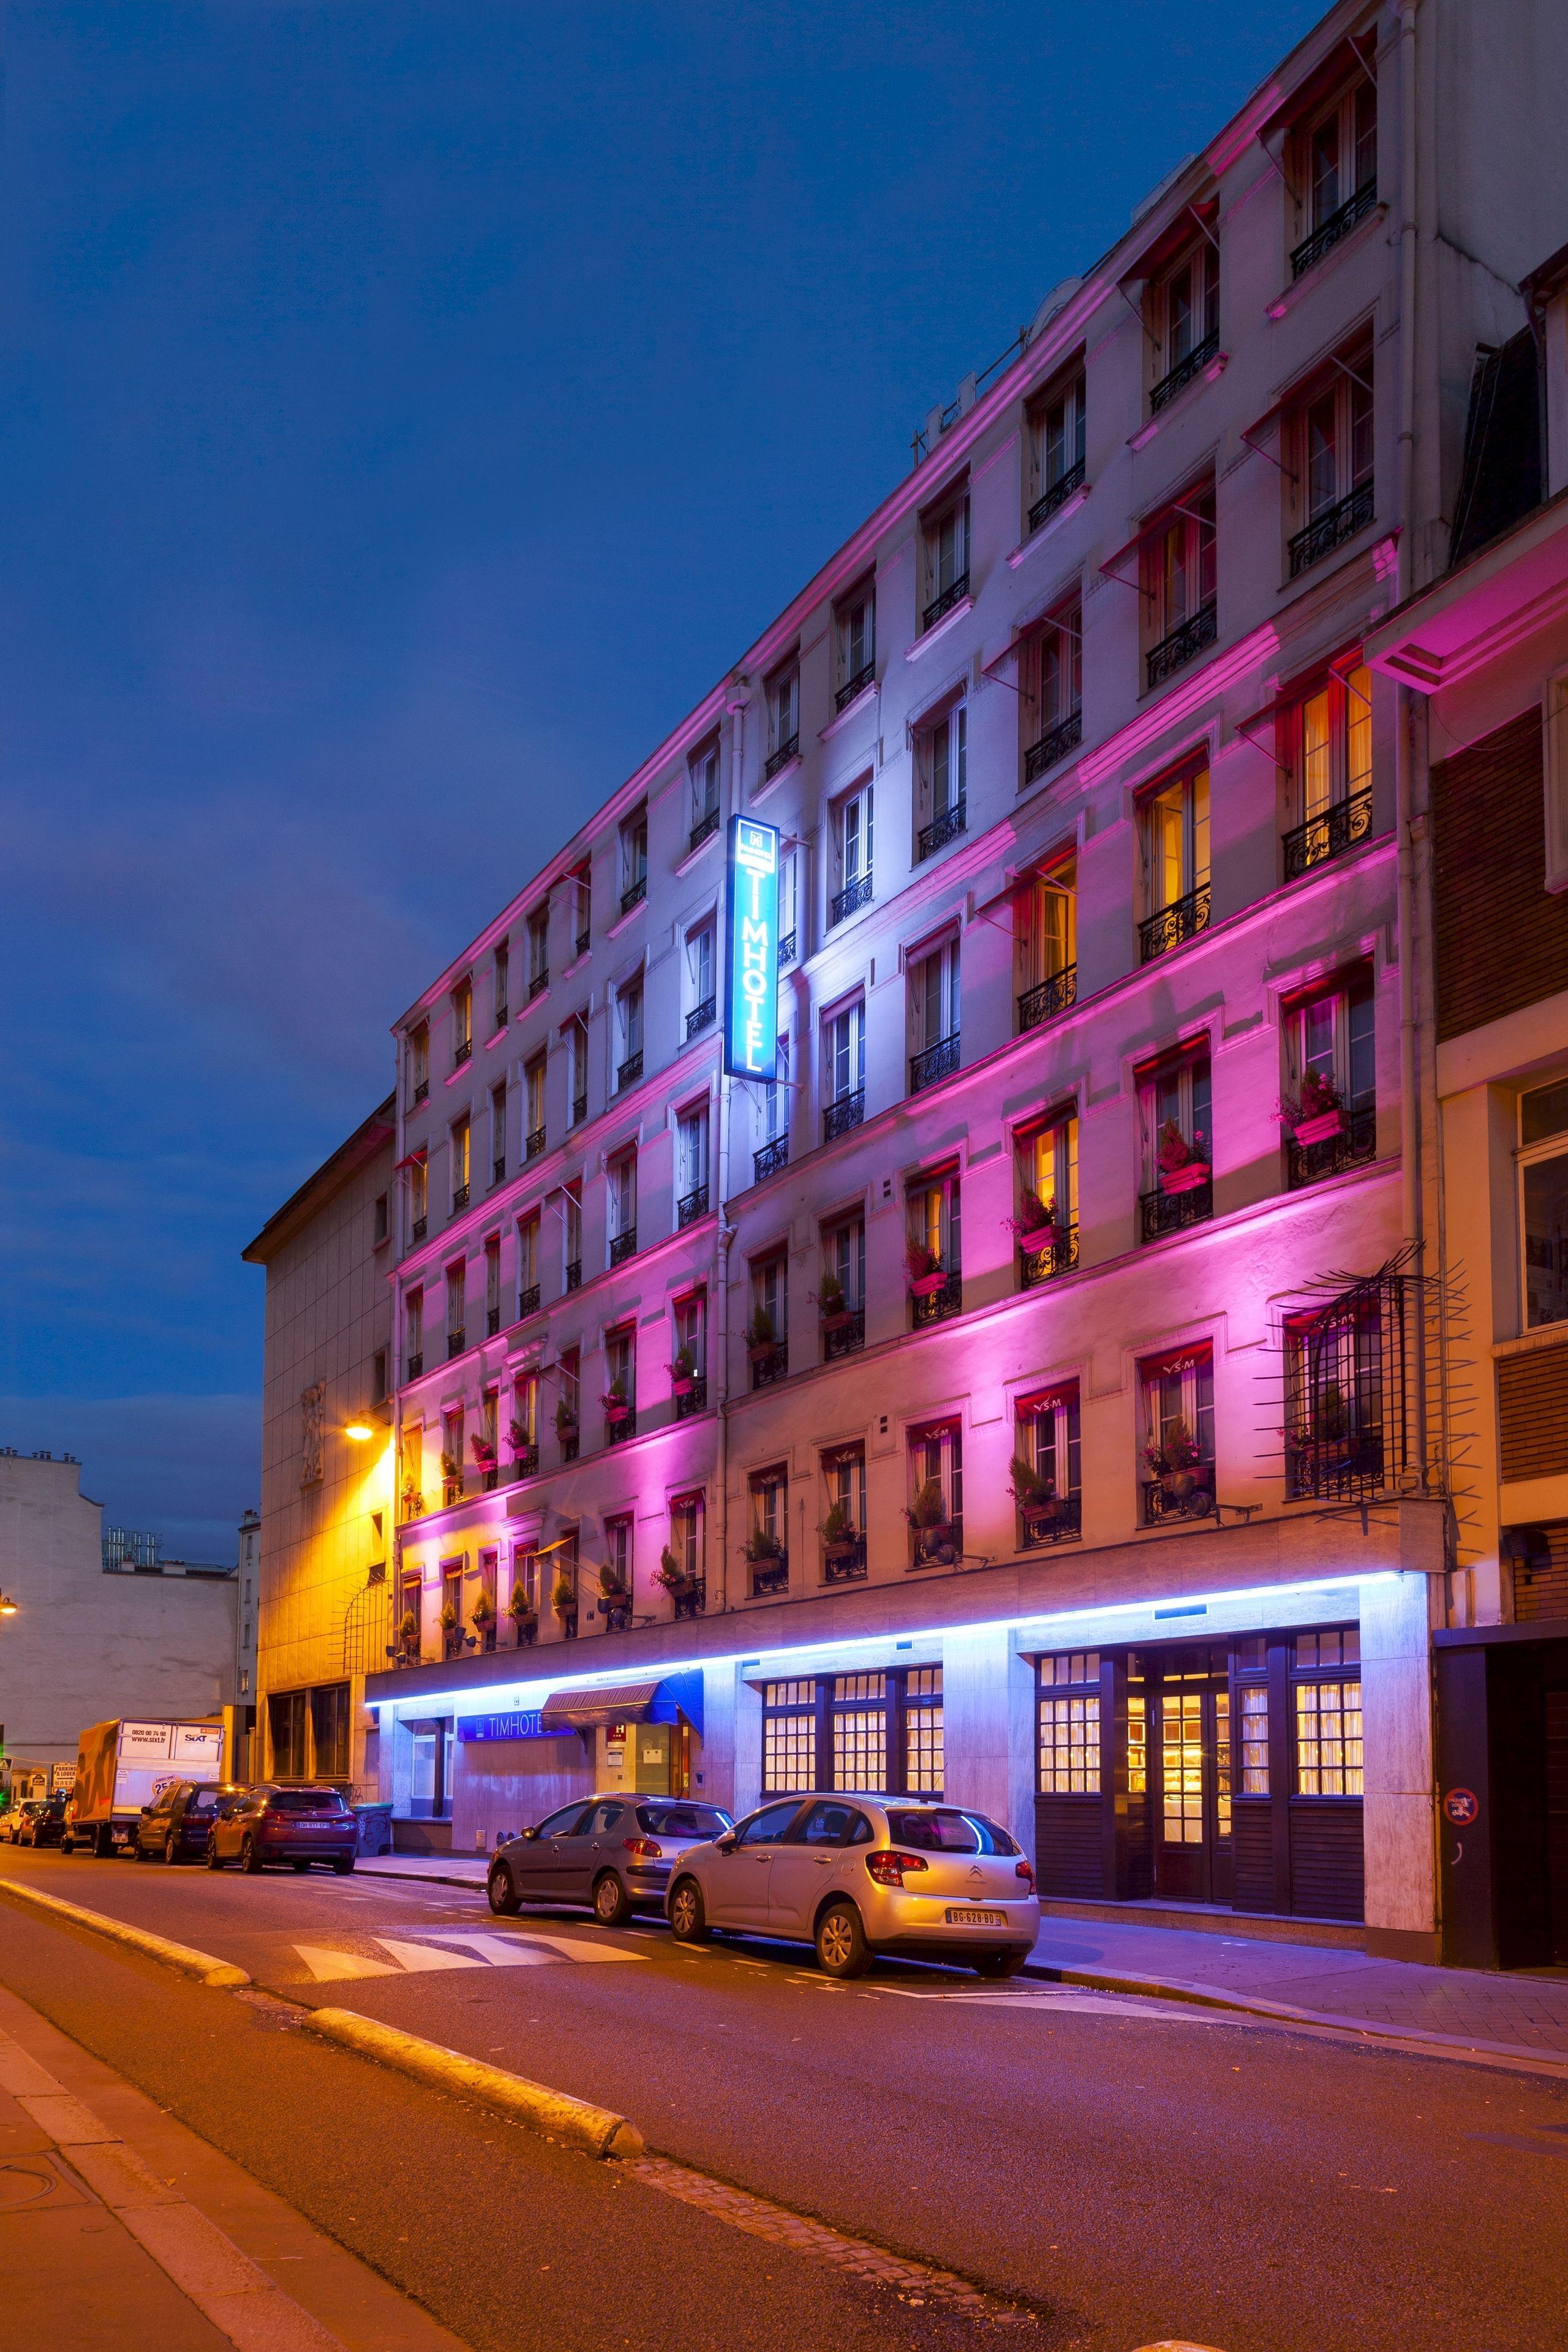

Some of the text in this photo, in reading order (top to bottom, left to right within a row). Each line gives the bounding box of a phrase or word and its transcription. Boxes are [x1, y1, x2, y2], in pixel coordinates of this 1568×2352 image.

[741, 869, 769, 1072] TIMHOTEL
[489, 1713, 550, 1736] TIMHOTE
[616, 1725, 625, 1733] H
